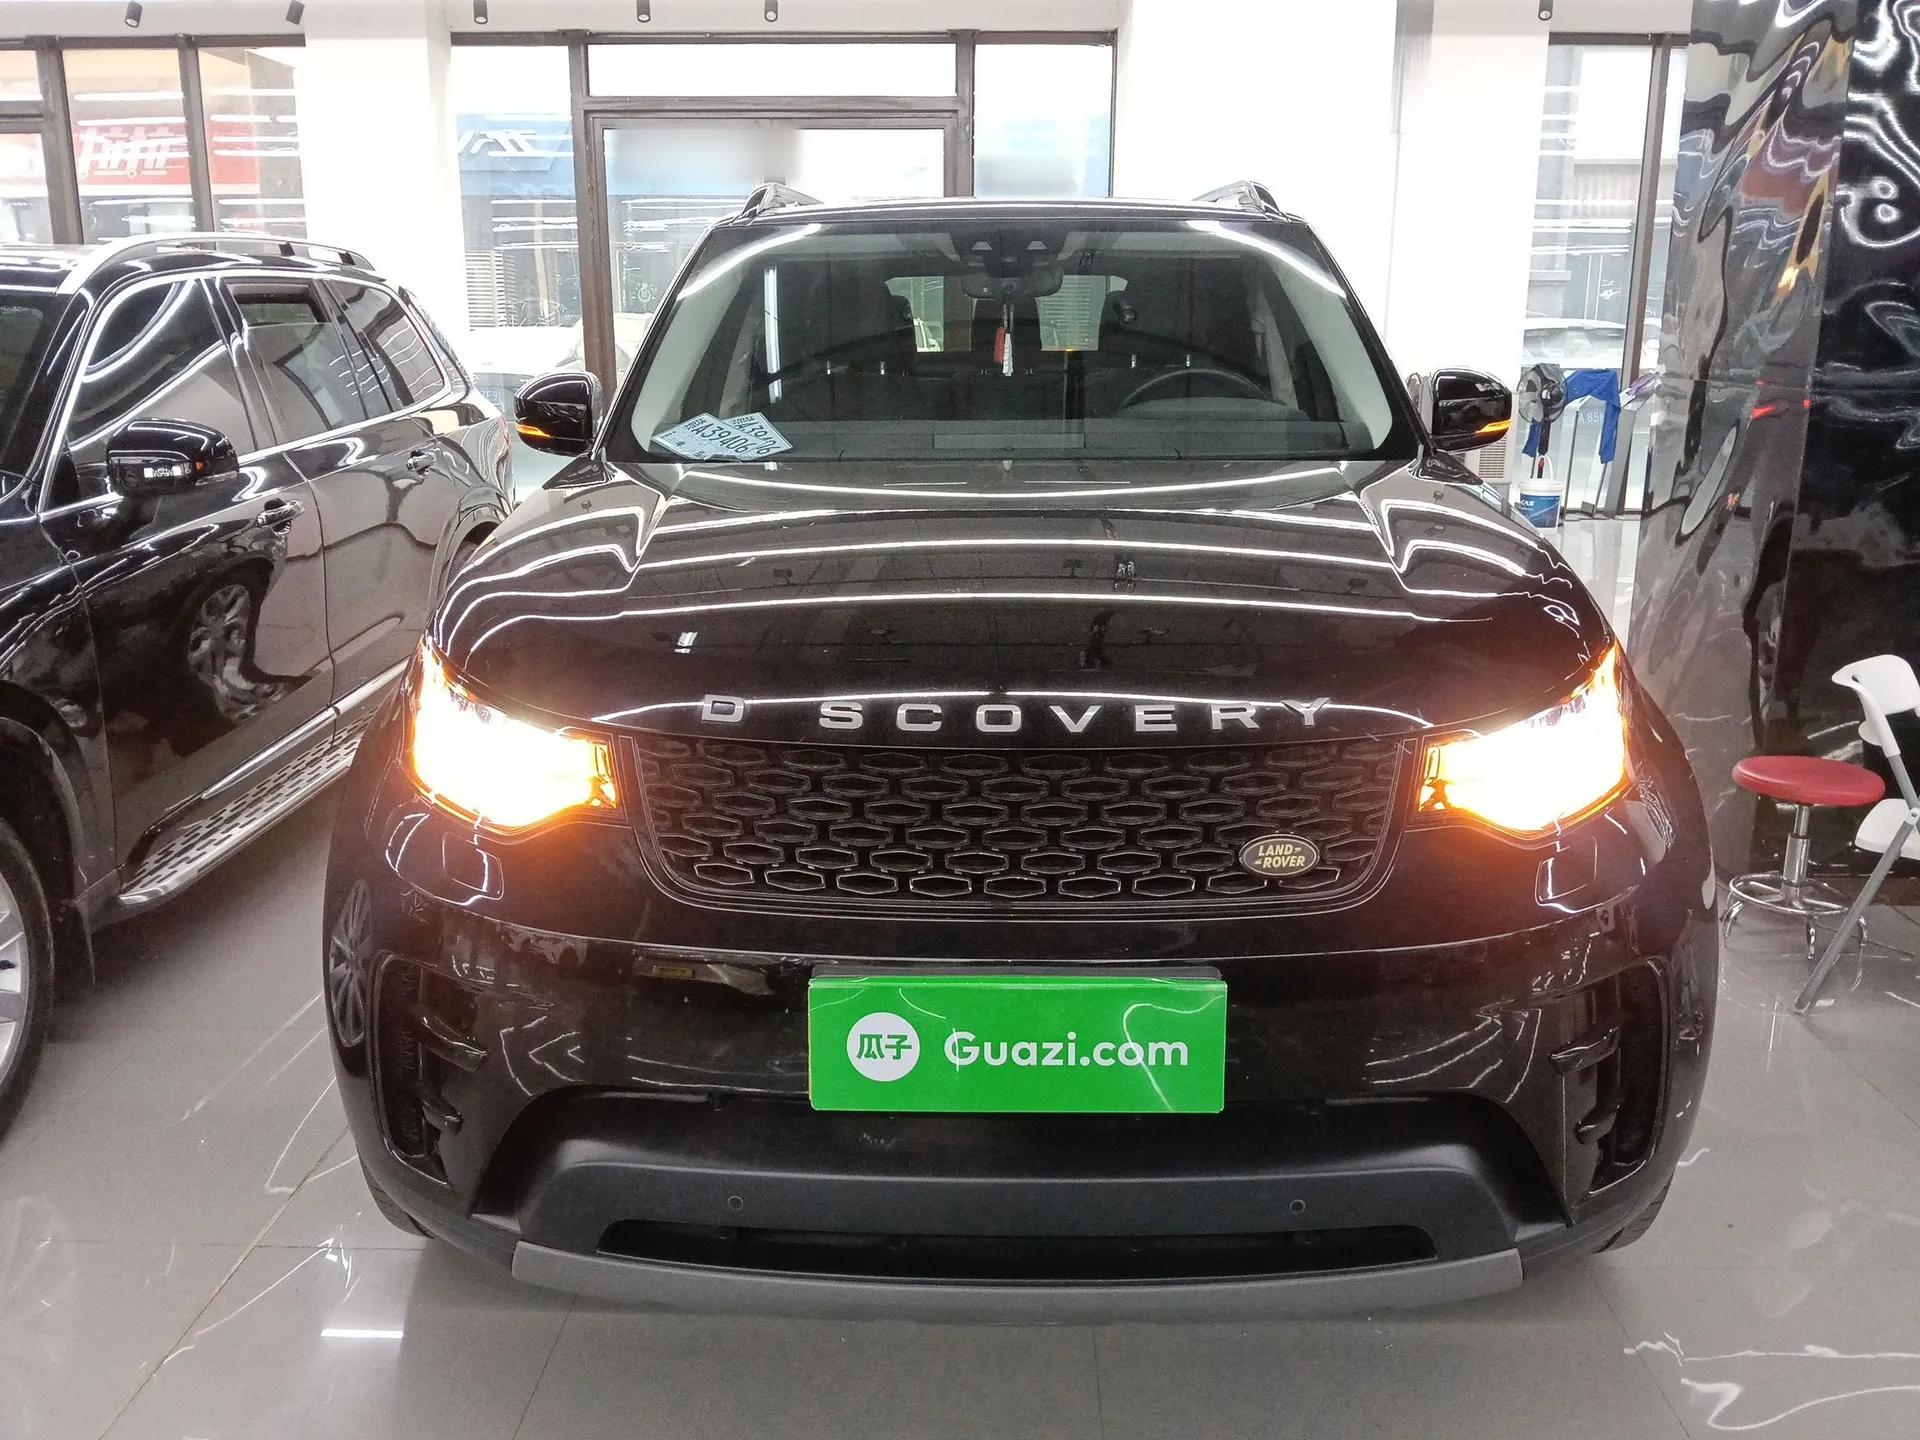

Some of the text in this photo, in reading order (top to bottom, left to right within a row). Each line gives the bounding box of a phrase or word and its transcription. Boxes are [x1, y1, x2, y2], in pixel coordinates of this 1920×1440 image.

[701, 694, 1330, 733] DSCOVERY
[857, 1034, 912, 1060] 瓜子
[944, 1031, 1188, 1067] Guazi.com
